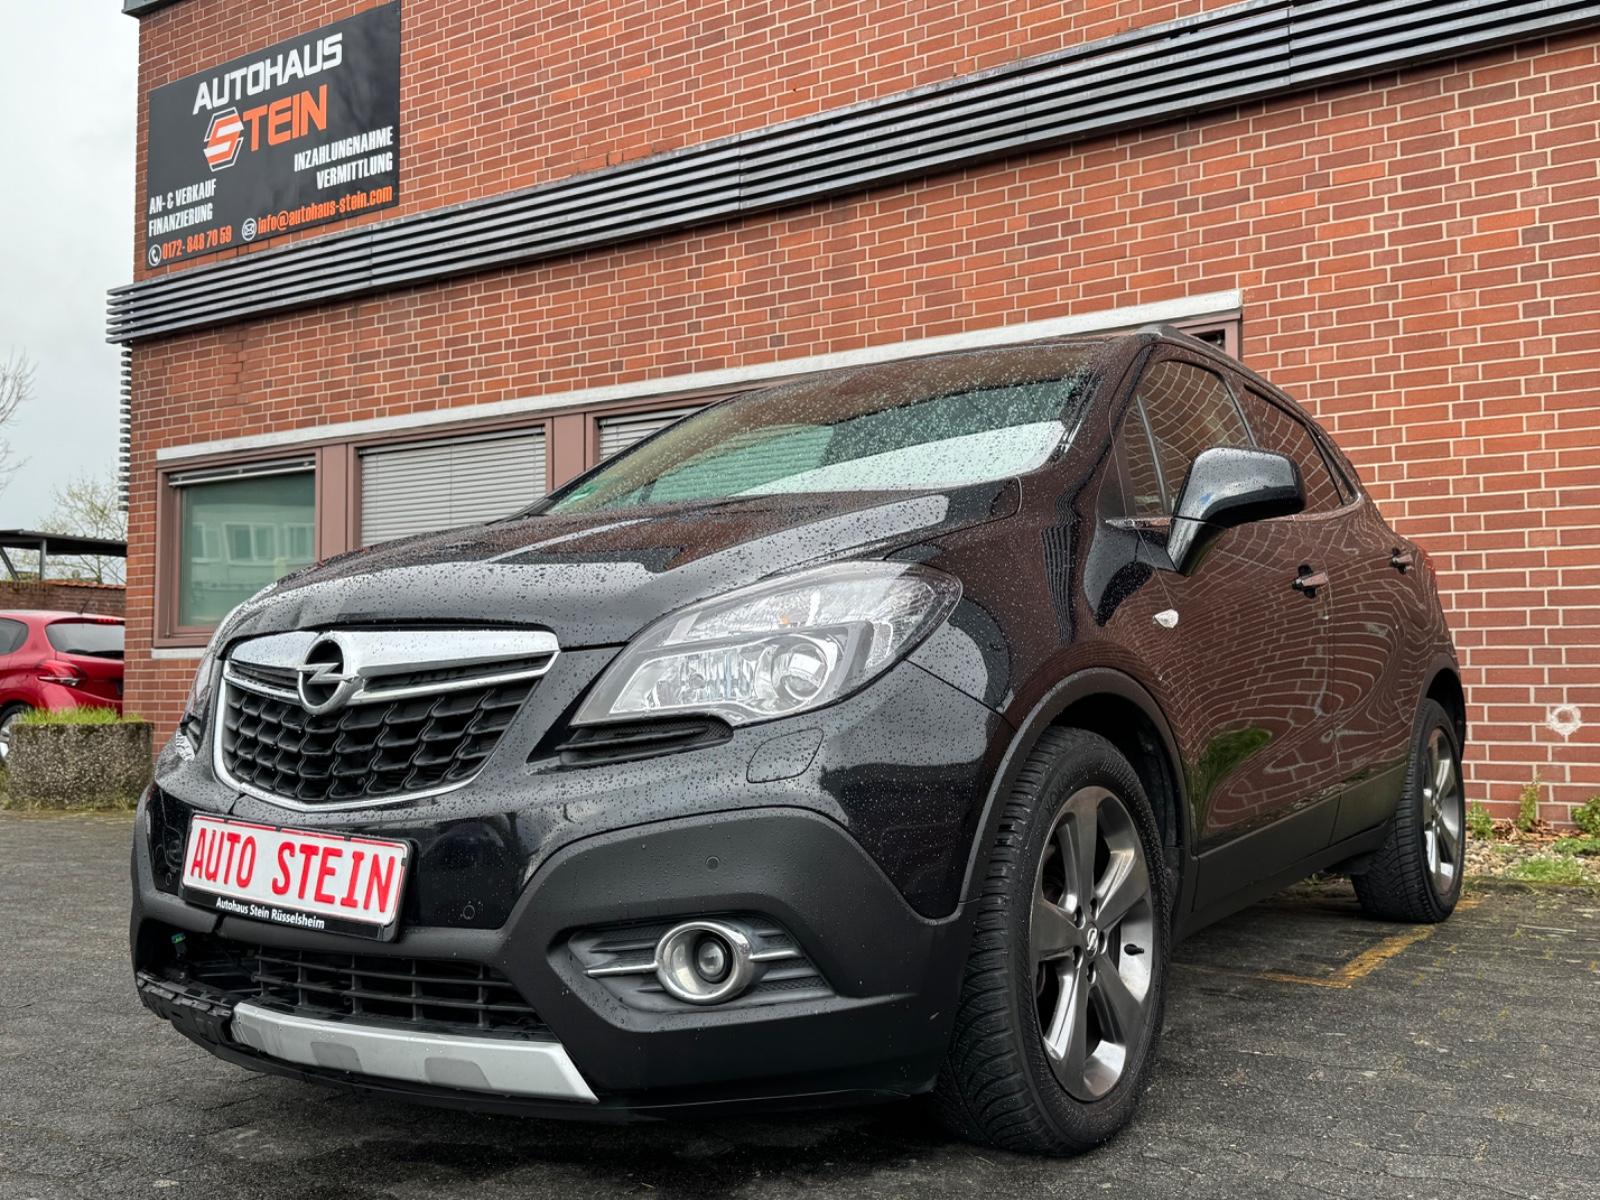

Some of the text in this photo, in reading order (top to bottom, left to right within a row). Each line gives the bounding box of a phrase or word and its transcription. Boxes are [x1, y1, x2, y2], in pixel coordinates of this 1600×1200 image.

[192, 32, 343, 115] AUTOHAUS
[204, 84, 328, 171] STEIN
[294, 125, 393, 172] INZAHLUNGNAHME
[316, 151, 393, 190] VERMITTLUNG
[149, 178, 217, 215] AN- & VERKAUF
[257, 185, 393, 235] info@autohaus-stein.com
[148, 202, 213, 238] FINANZIERUNG
[207, 228, 218, 249] 70
[219, 224, 232, 245] 59
[190, 827, 396, 914] AUTO STEIN
[216, 896, 325, 930] Autohaus Stein Rüsselsheim
